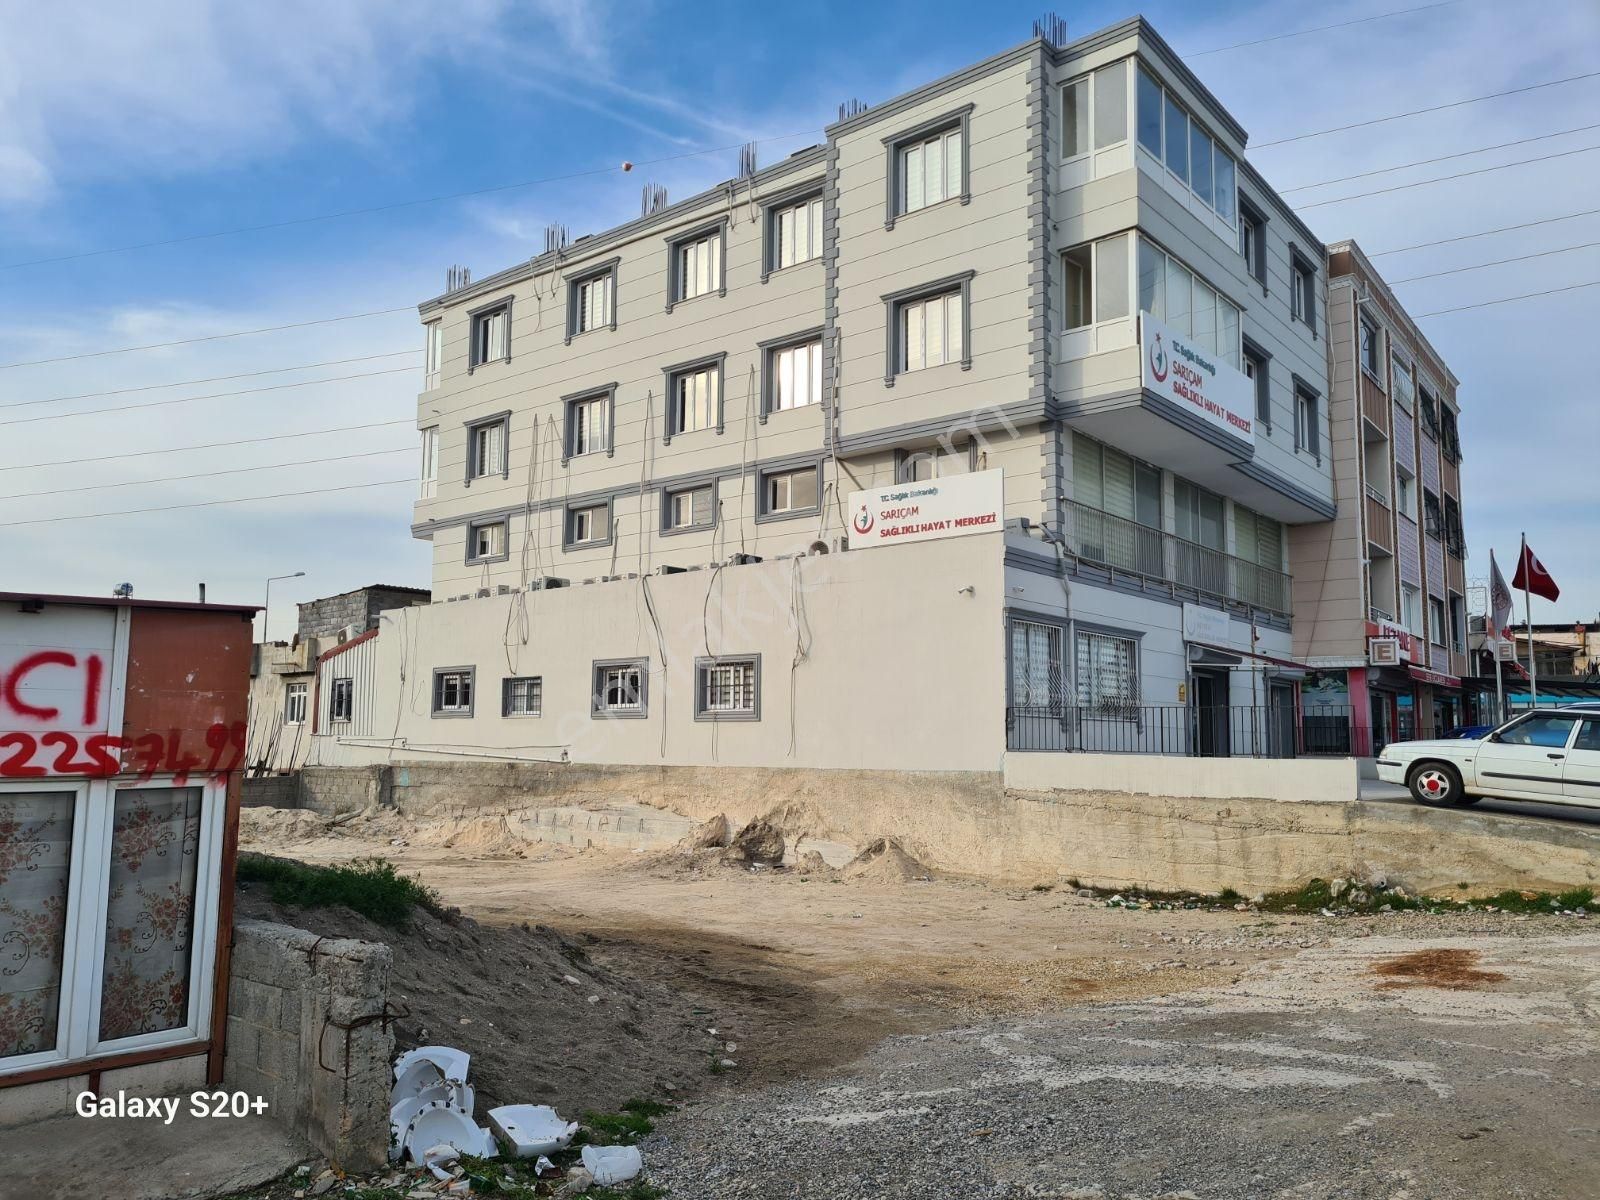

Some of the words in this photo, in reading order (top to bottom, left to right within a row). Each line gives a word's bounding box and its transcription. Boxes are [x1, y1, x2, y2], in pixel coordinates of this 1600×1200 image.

[1173, 360, 1203, 389] SARIÇAM
[1173, 380, 1203, 408] SAĞLIKLI
[1226, 410, 1251, 434] MERKEZİ
[880, 506, 919, 521] SARIÇAM
[880, 523, 920, 538] SAĞLIKLI
[954, 511, 996, 527] MERKEZİ
[0, 650, 103, 726] CI
